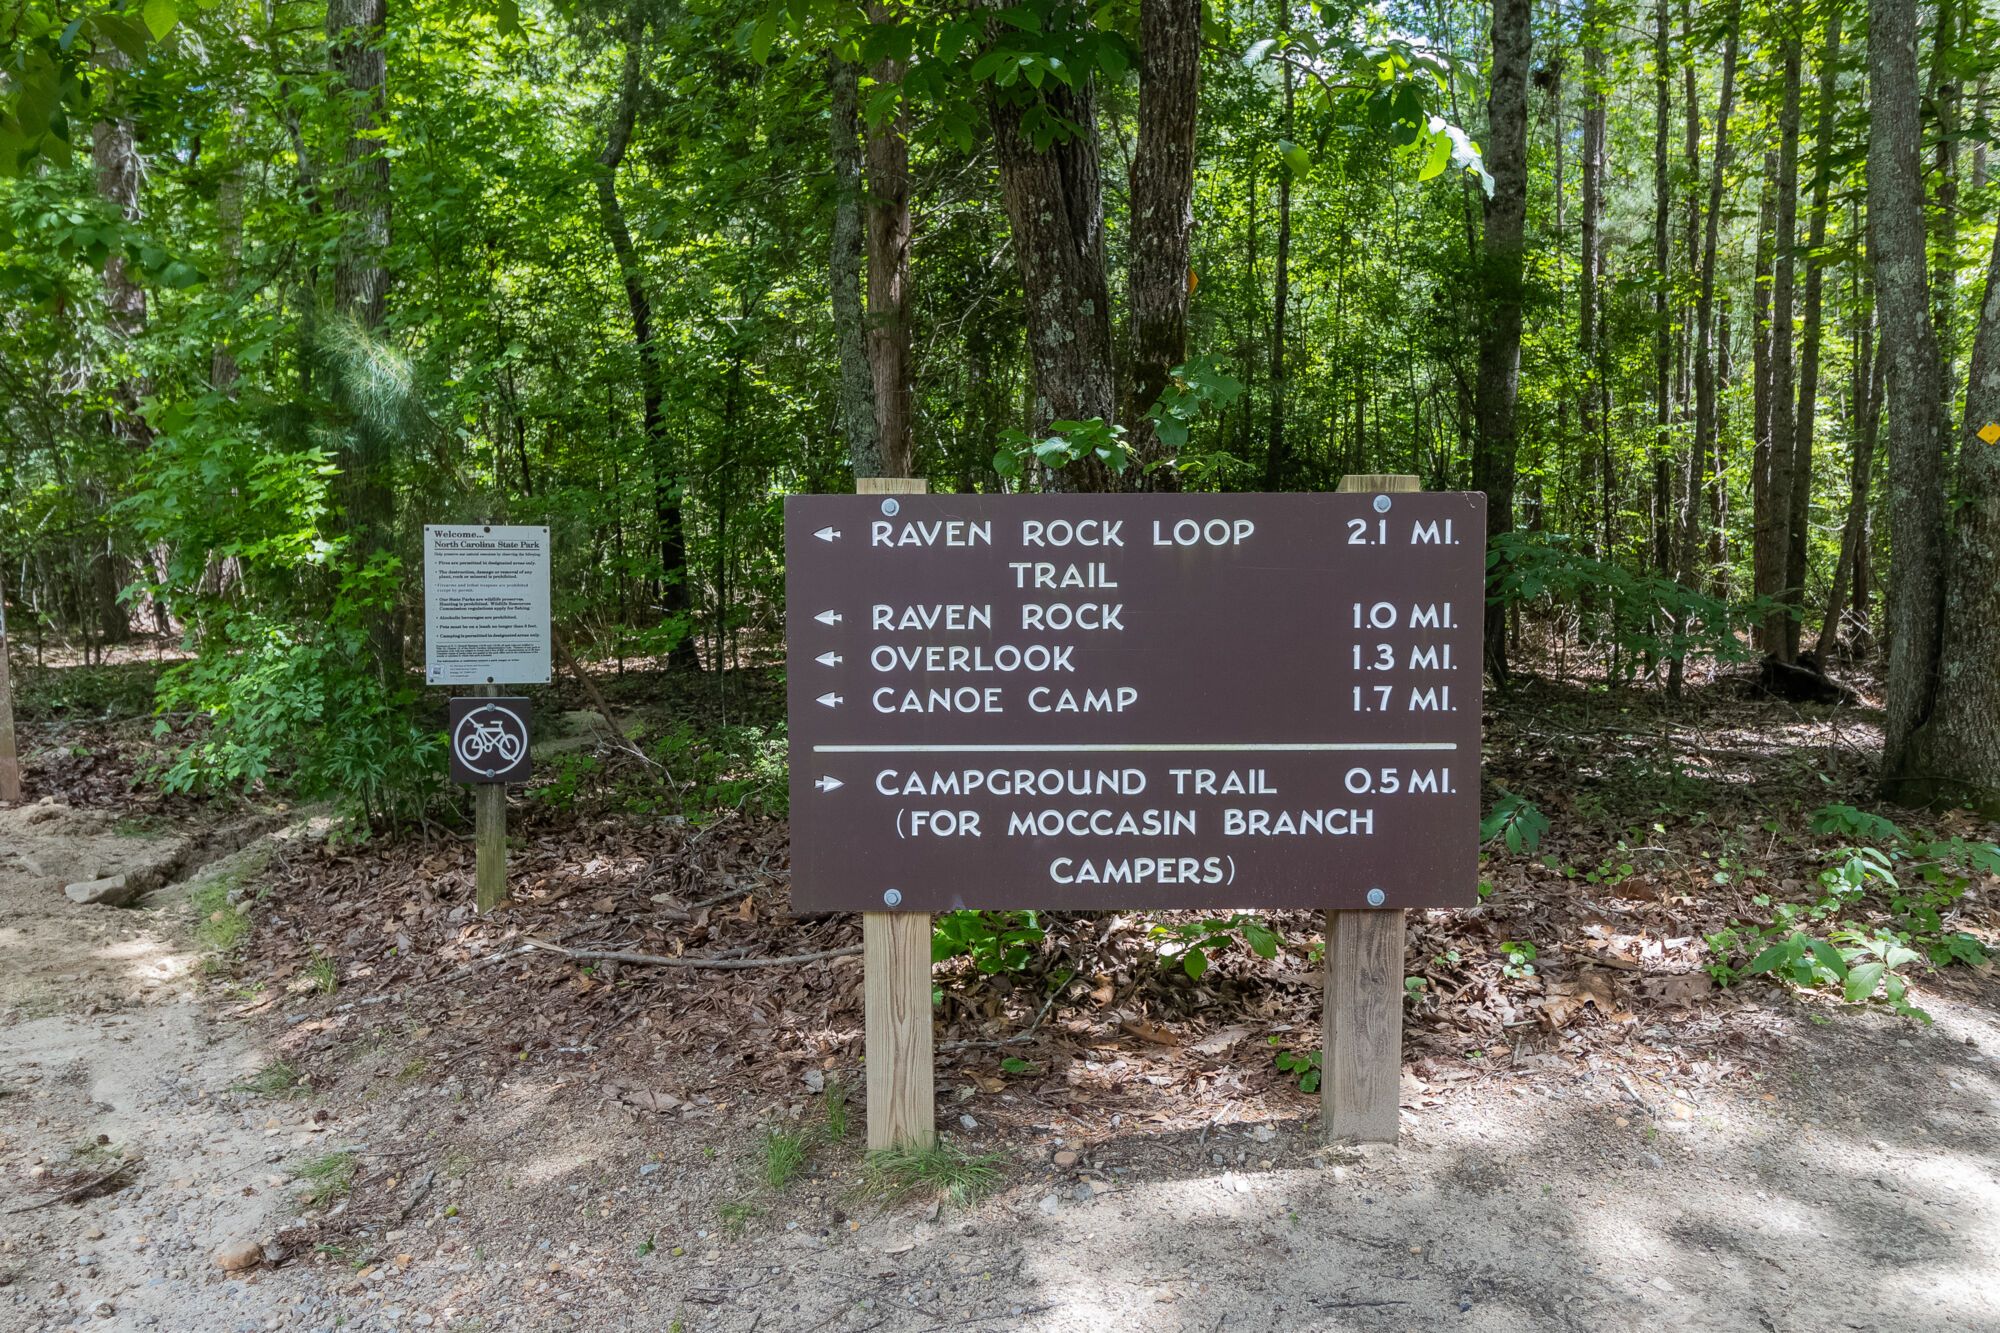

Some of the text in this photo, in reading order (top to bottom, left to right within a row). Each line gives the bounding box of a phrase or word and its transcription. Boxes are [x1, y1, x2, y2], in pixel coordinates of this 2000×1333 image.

[434, 530, 484, 538] Welcome...
[871, 518, 1255, 548] RAVEN ROCK LOOP
[1346, 518, 1460, 545] 2.1 MI.
[1008, 562, 1118, 590] TRAIL
[872, 602, 1125, 632] RAVEN ROCK
[1352, 601, 1458, 629] 1.0 MI.
[870, 644, 1076, 673] OVERLOOK
[1352, 643, 1458, 671] 1.3 MI.
[872, 686, 1138, 714] CANOE CAMP
[1352, 685, 1457, 712] 1.7 MI.
[875, 768, 1278, 796] CAMPGROUND TRAIL
[1344, 767, 1457, 794] 0.5 MI.
[896, 808, 1374, 839] (FOR MOCCASIN BRANCH
[1049, 855, 1236, 886] CAMPERS)
